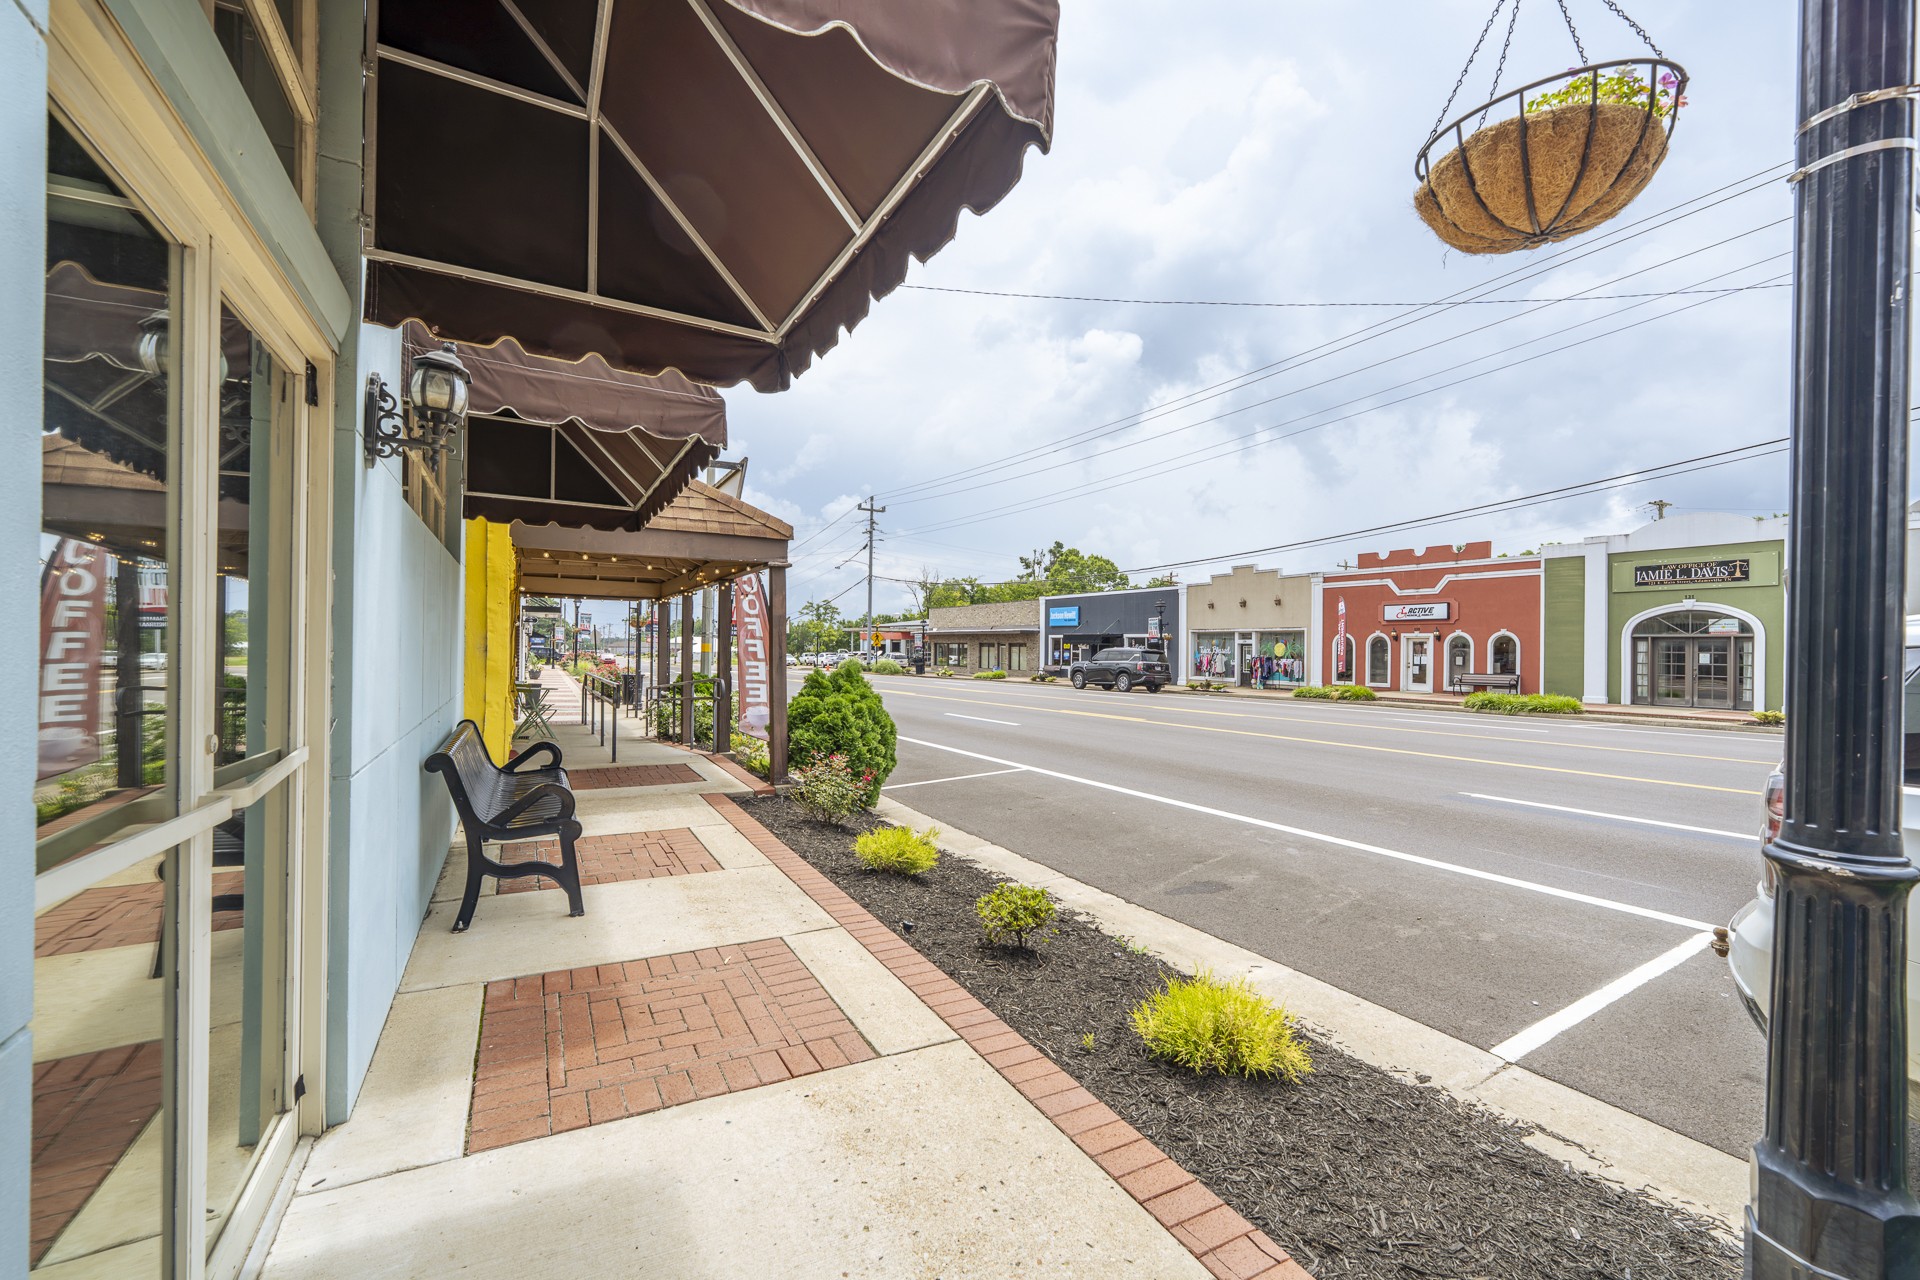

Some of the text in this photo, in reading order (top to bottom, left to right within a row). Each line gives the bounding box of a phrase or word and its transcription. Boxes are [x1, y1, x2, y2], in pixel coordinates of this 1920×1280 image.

[1678, 562, 1706, 570] OFFICE
[1706, 560, 1718, 568] OF
[1636, 566, 1728, 583] JAMIE L. DAVIS
[1407, 606, 1435, 614] ACTIVE
[40, 539, 97, 723] COFFEE
